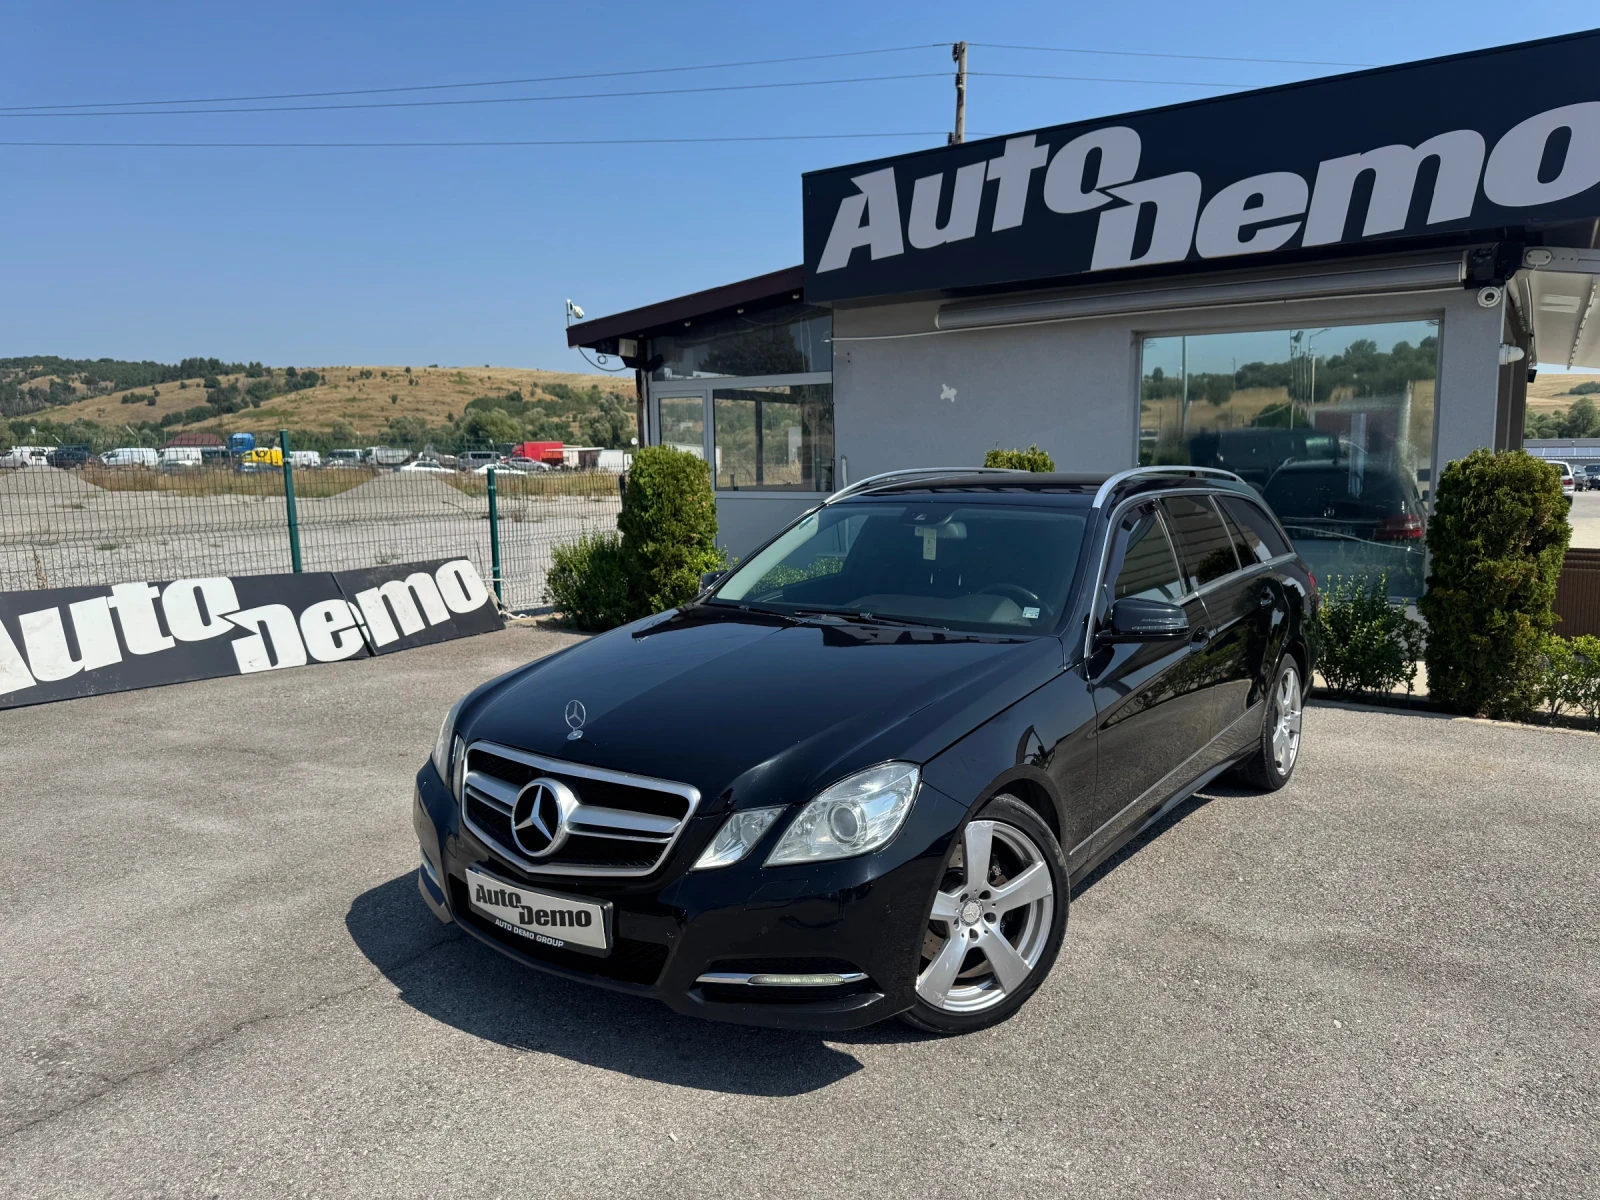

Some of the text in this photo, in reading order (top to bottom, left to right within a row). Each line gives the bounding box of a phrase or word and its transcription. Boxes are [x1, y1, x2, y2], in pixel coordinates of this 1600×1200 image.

[816, 101, 1600, 274] Auto Demo
[231, 560, 488, 674] Demo
[476, 884, 592, 927] Auto Demo
[495, 919, 564, 947] AUTO DEMO GROUP
